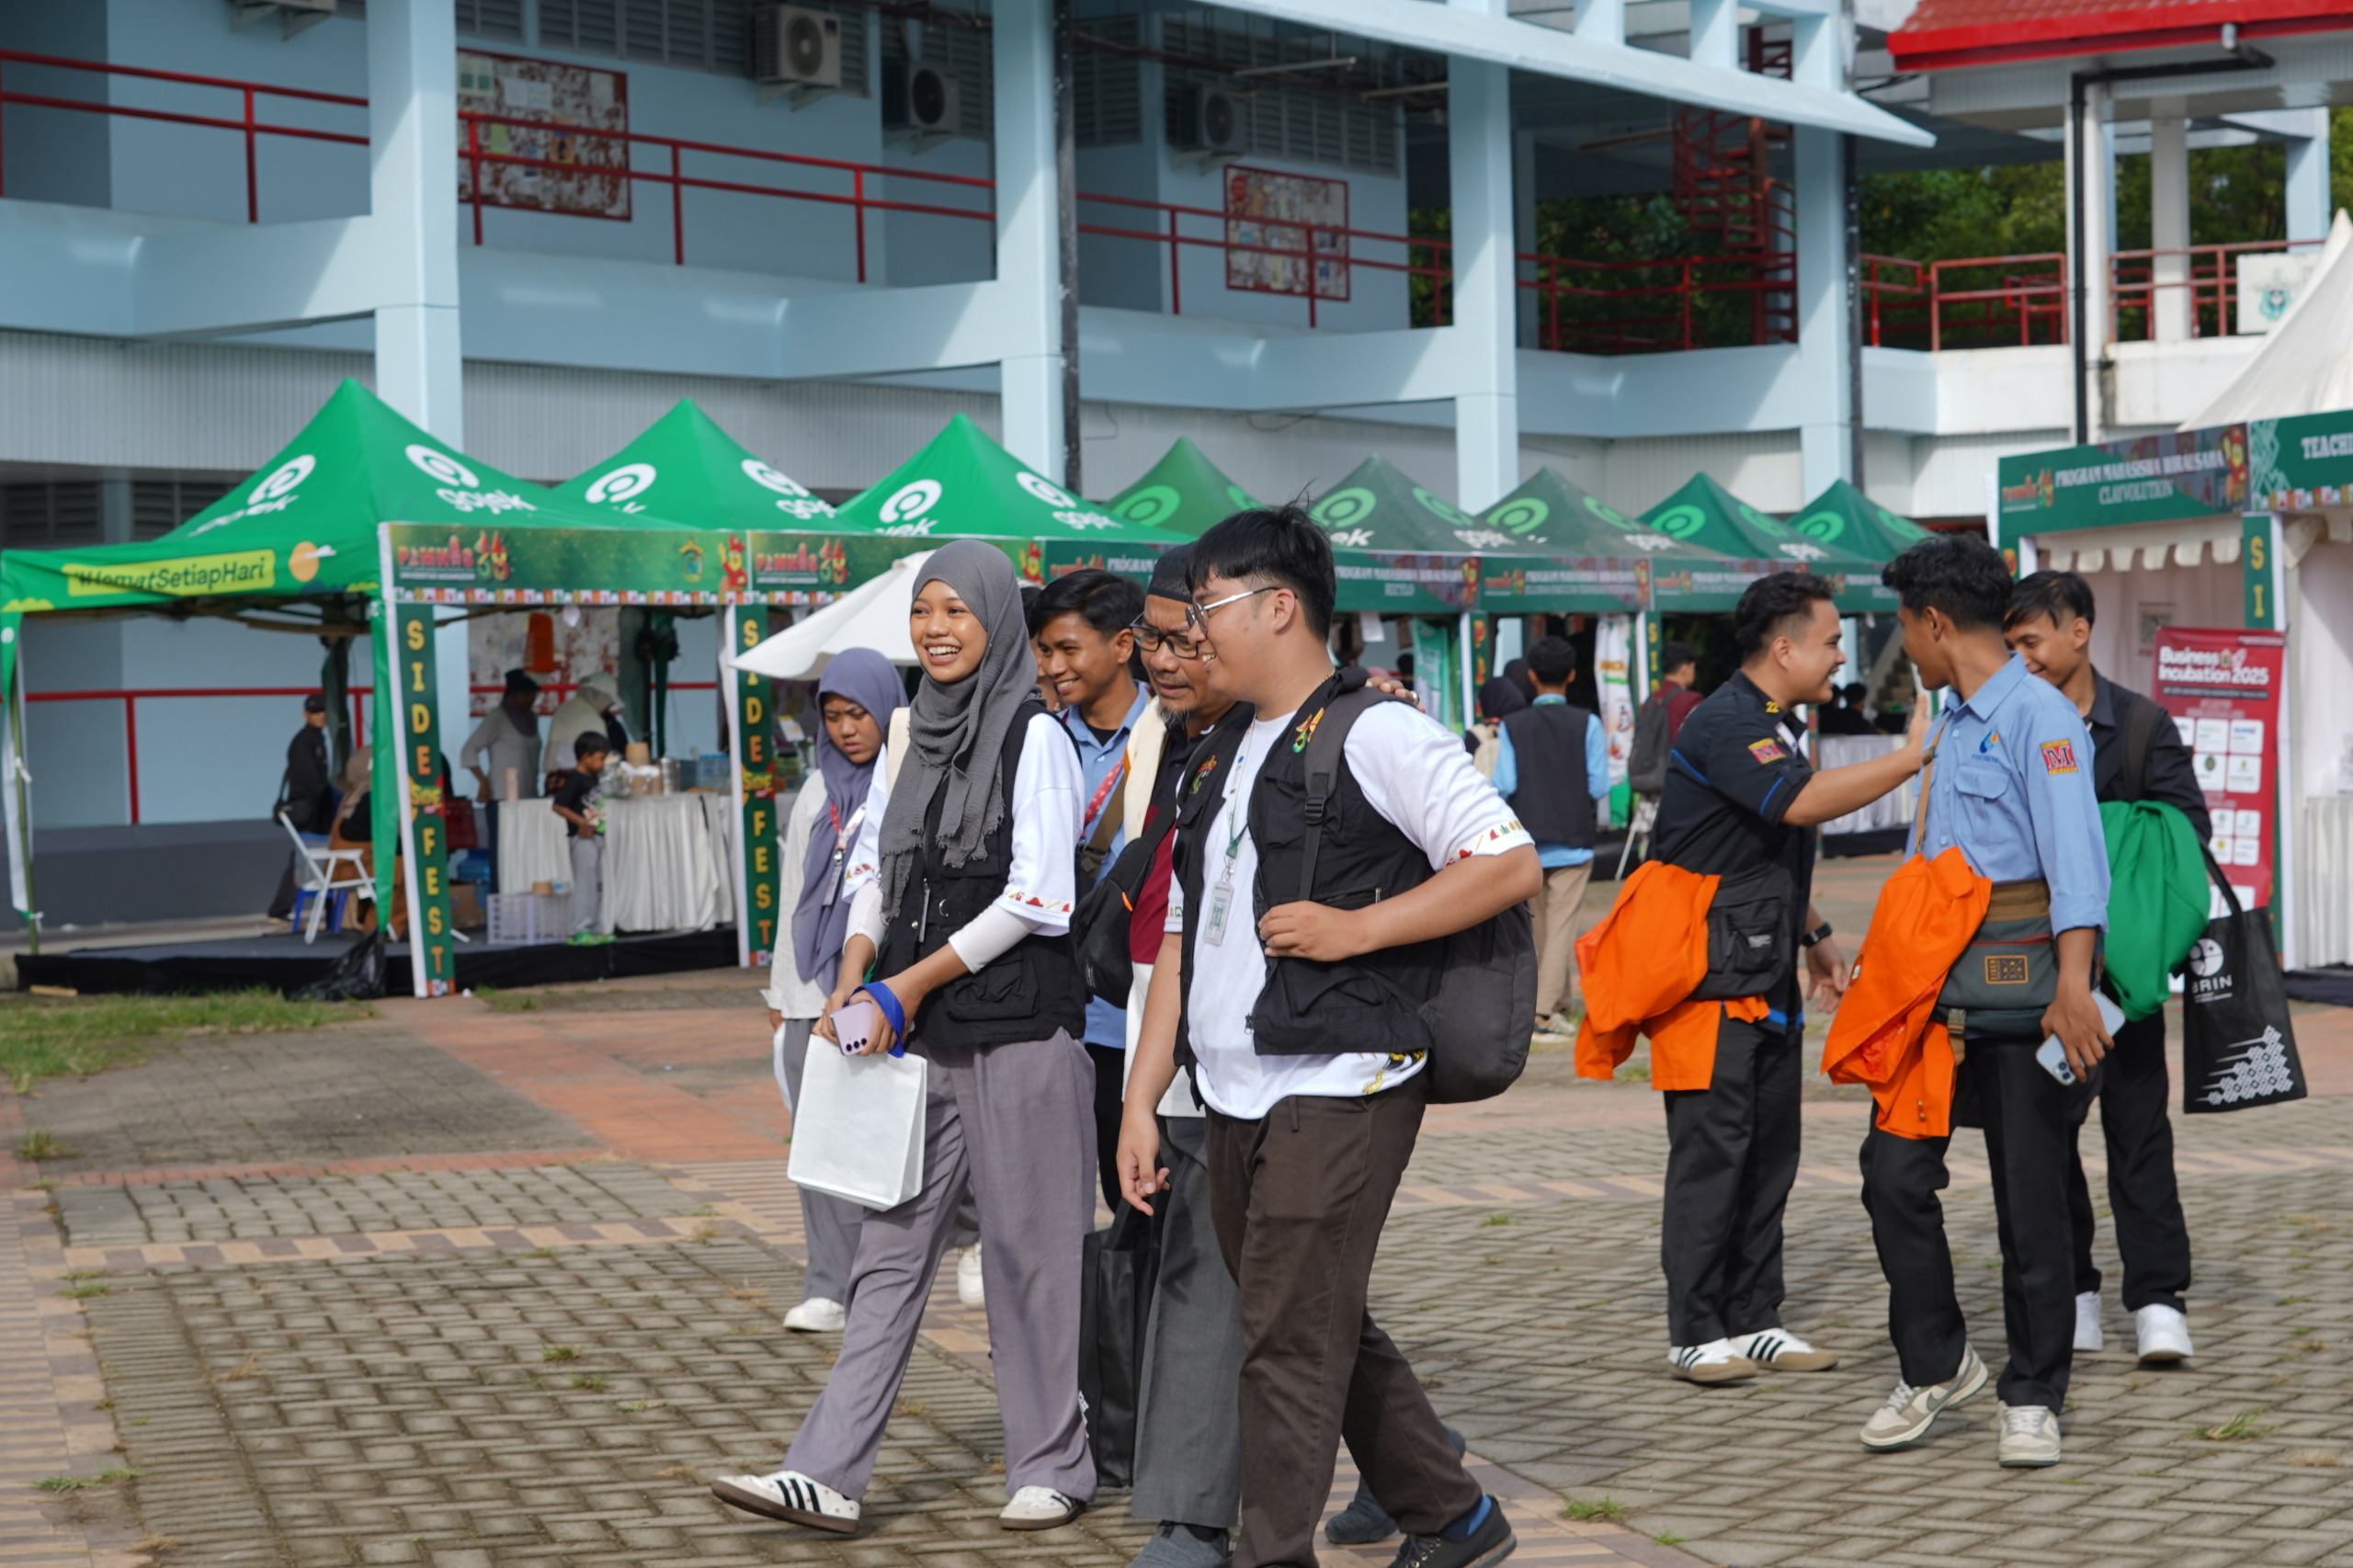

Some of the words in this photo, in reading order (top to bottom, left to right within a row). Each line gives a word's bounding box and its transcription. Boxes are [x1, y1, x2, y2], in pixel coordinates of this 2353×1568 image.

[2055, 465, 2102, 489] PROGRAM
[2159, 645, 2220, 666] Business
[2158, 664, 2231, 684] Incubation
[2231, 666, 2269, 686] 2025
[743, 619, 764, 762] SDE
